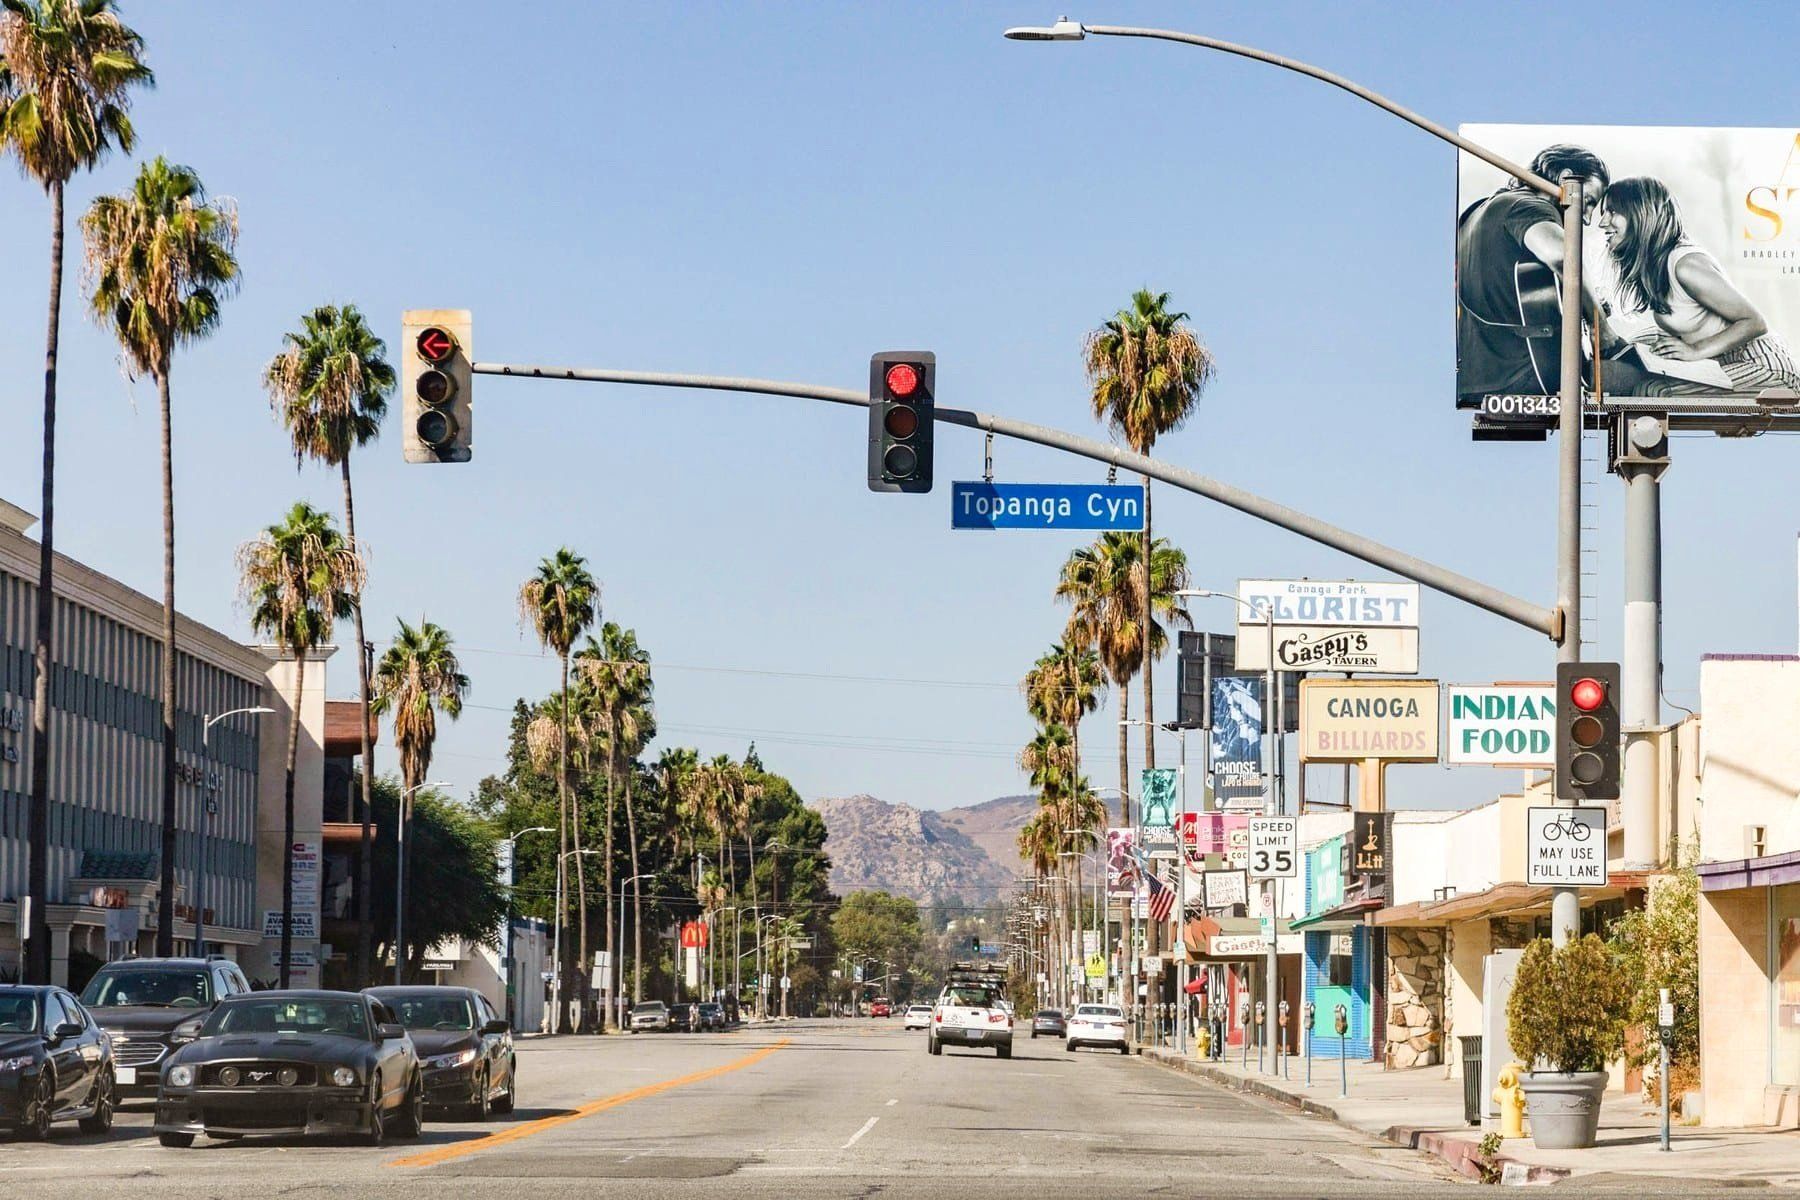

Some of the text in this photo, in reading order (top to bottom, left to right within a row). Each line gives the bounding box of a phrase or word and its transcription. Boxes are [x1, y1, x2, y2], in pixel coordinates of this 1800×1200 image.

[1744, 186, 1800, 242] S
[1743, 250, 1795, 258] BRADLEY
[1782, 266, 1800, 274] LA
[1488, 396, 1560, 414] 001343
[960, 491, 1138, 523] Topanga Cyn
[1288, 583, 1367, 596] Canoga Park
[1249, 595, 1408, 622] FLORIST
[1277, 632, 1369, 666] Casey's
[1332, 656, 1377, 666] TAVERN
[1327, 698, 1419, 718] CANOGA
[1453, 695, 1556, 720] INDIAN
[1318, 731, 1426, 751] BILLIARDS
[1463, 729, 1550, 754] FOOD
[1215, 761, 1256, 774] CHOOSE
[1253, 822, 1293, 832] SPEED
[1257, 836, 1289, 846] LIMIT
[1254, 850, 1292, 872] 35
[1539, 847, 1594, 860] MAY USE
[1533, 864, 1600, 877] FULL LANE
